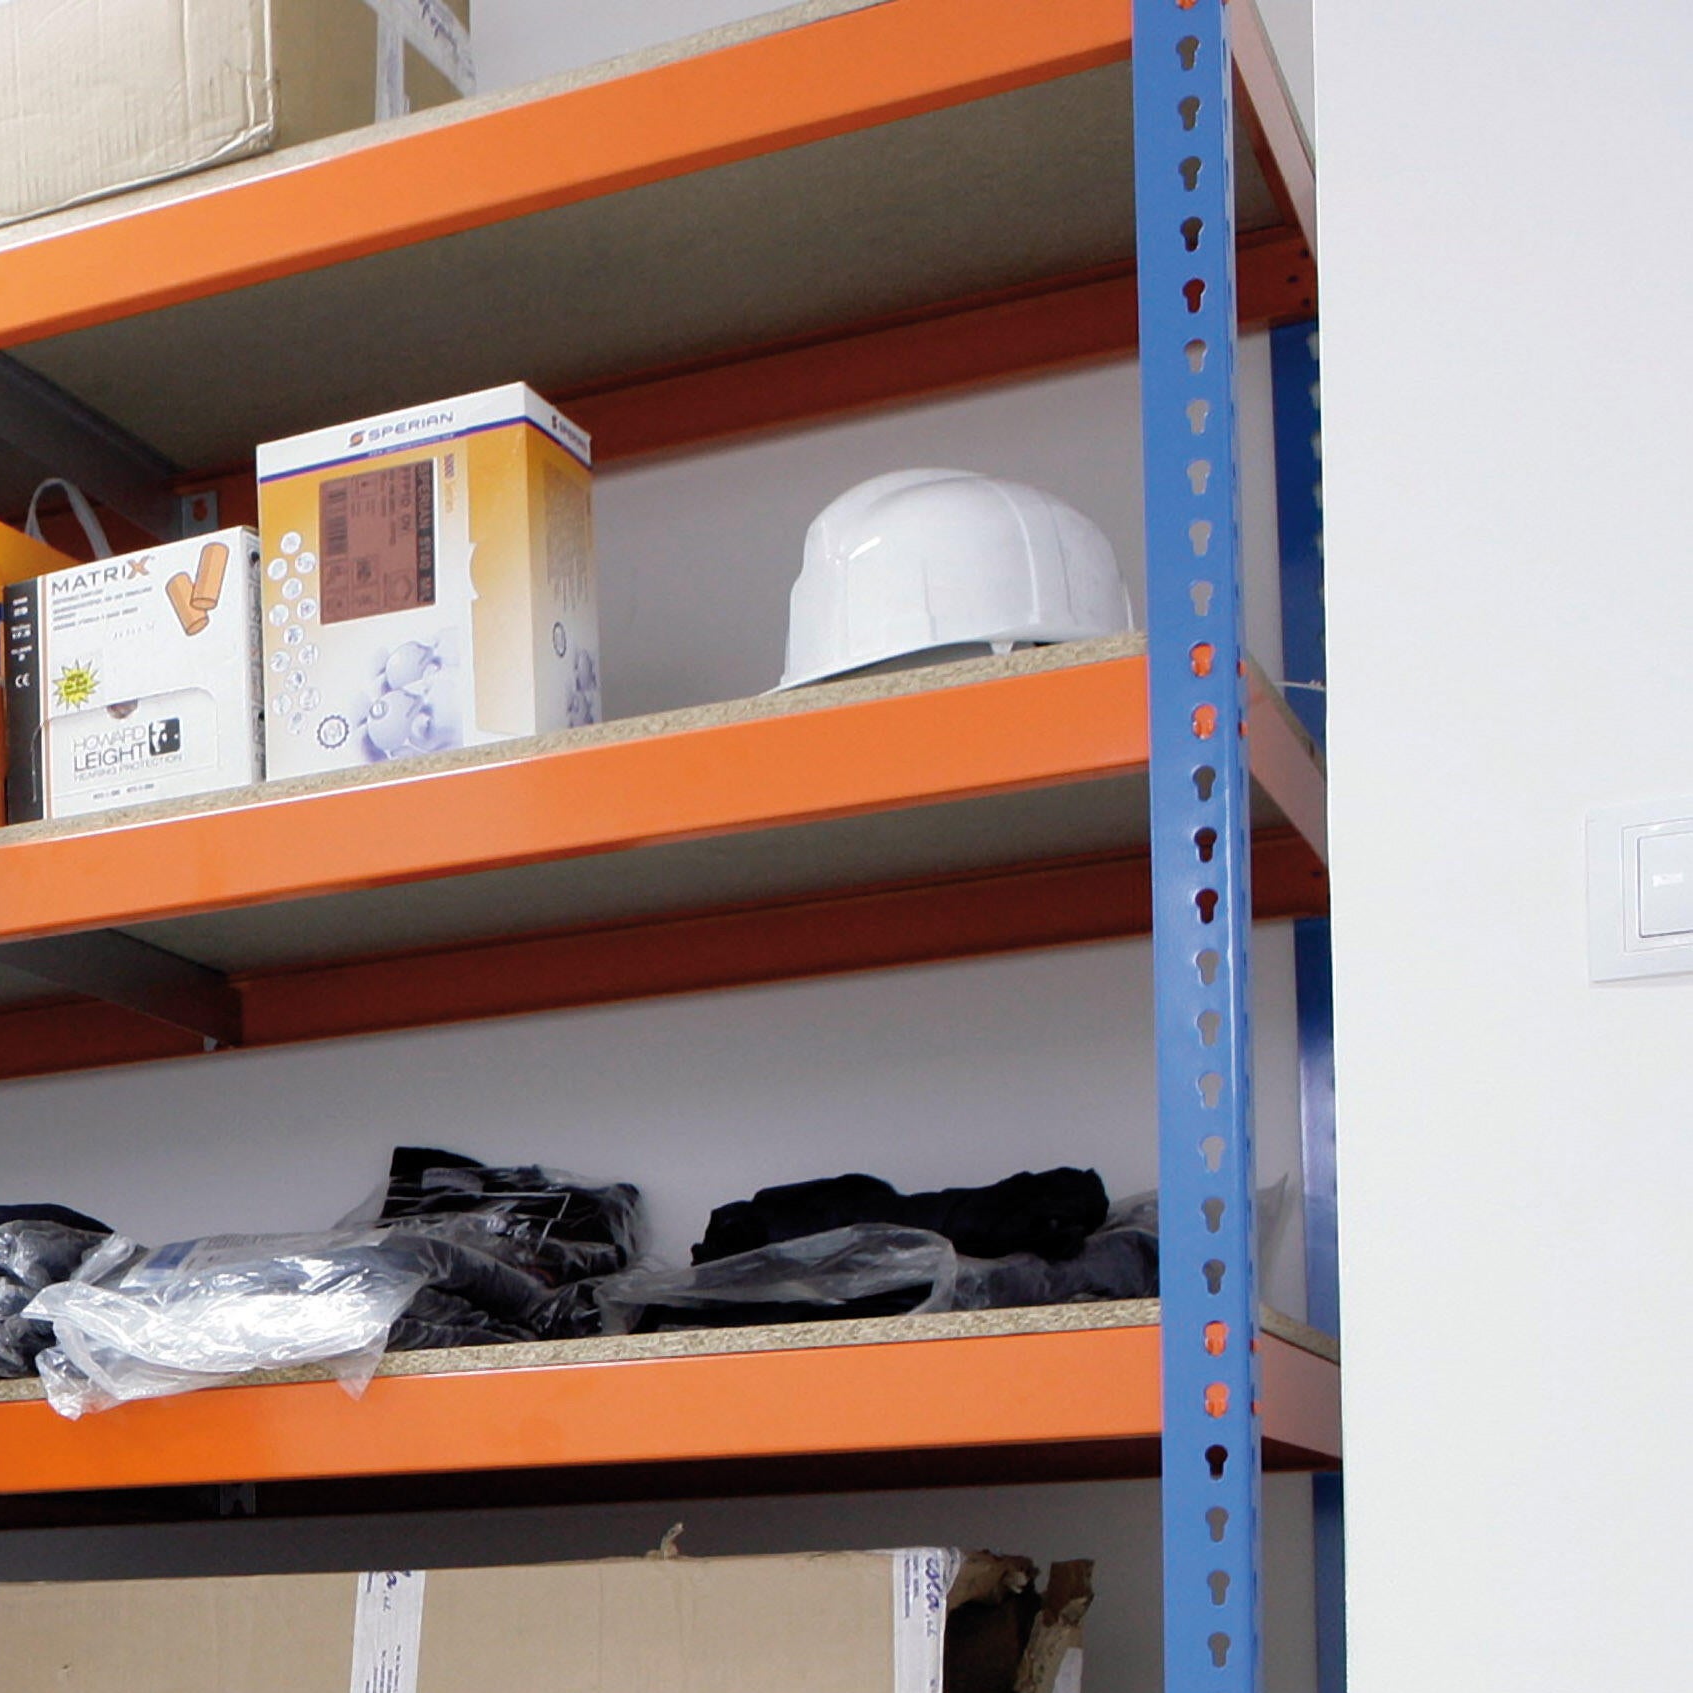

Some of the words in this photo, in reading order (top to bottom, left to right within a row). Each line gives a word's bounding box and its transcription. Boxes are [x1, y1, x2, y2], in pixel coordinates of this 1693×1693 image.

[368, 411, 454, 442] SPERIAN
[52, 556, 150, 596] MATRIX
[74, 725, 146, 752] HOWARD
[74, 742, 146, 772] LEIGHT
